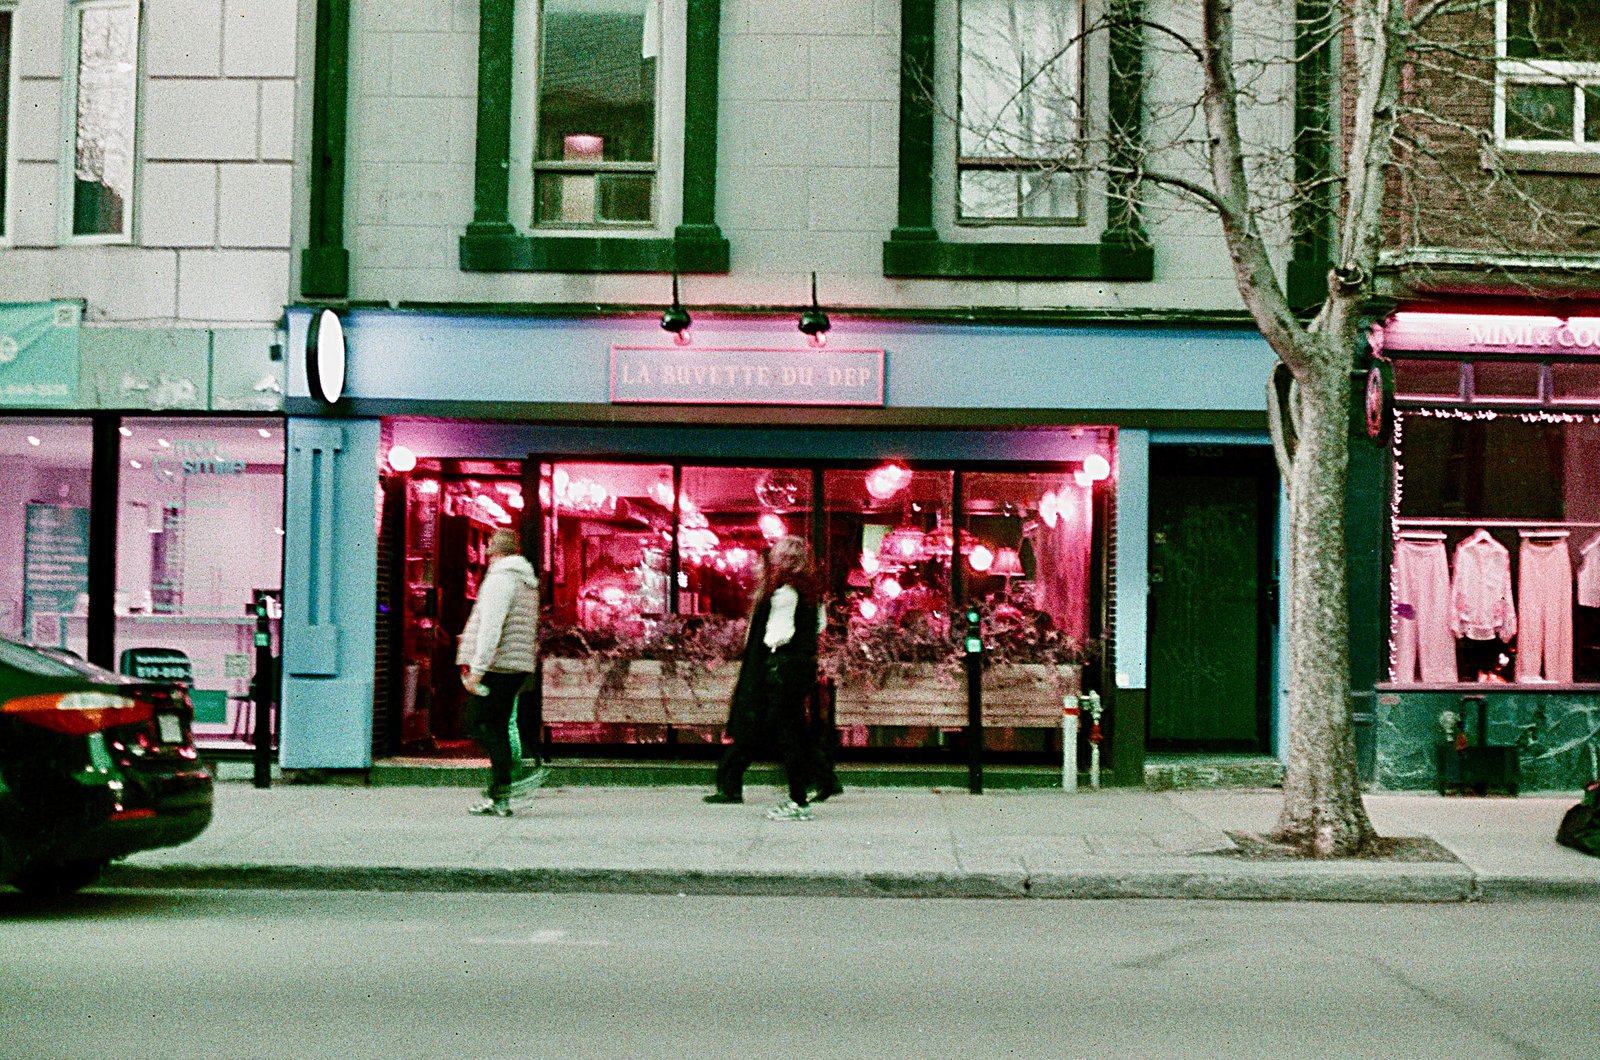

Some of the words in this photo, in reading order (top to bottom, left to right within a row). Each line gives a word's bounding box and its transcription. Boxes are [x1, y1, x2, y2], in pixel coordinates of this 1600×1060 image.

[1469, 322, 1533, 346] MIMI
[621, 364, 651, 385] LA
[662, 365, 770, 386] BUVETTE
[782, 366, 814, 386] DU
[828, 367, 872, 387] DEP
